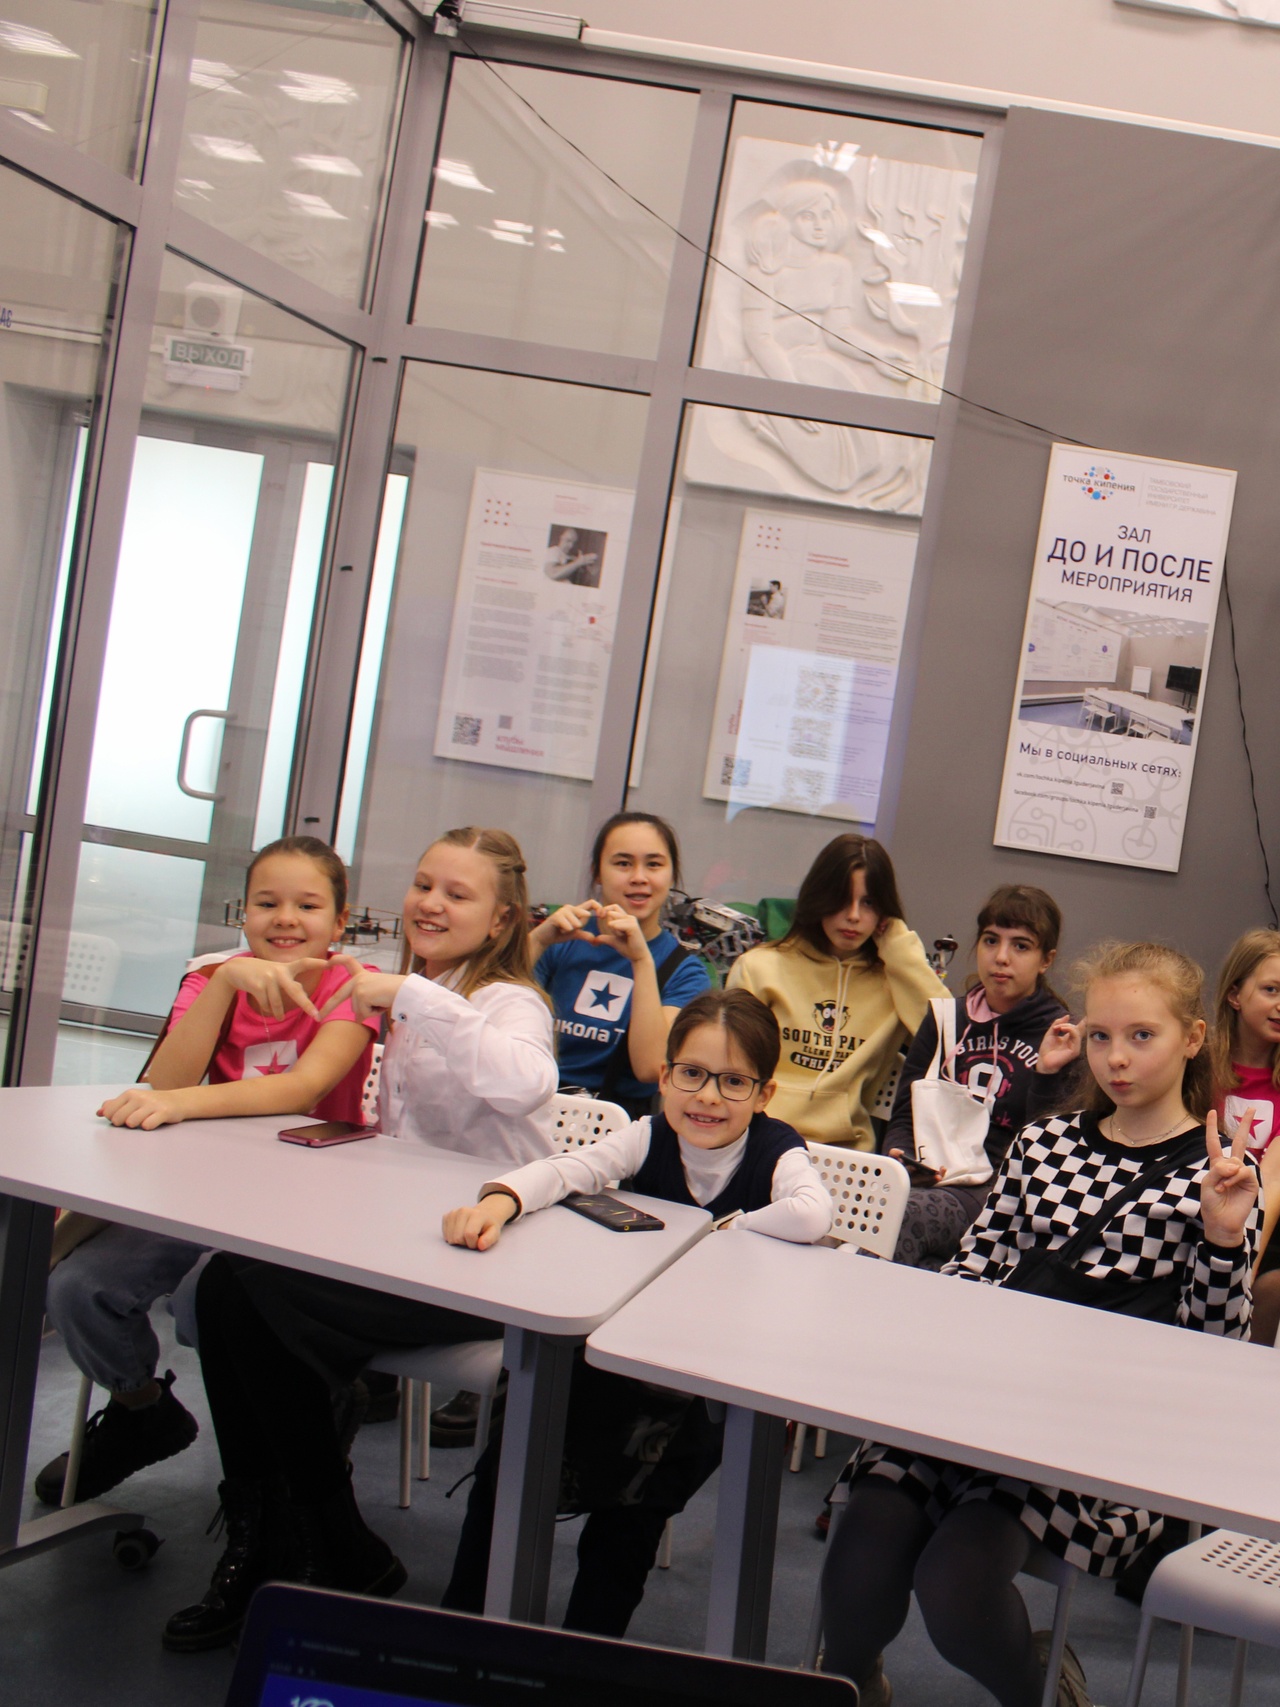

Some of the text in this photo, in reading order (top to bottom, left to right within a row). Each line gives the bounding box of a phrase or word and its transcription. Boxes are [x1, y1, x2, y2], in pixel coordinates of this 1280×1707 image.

[176, 344, 242, 367] ВЫХОД
[1063, 474, 1136, 493] точка кипения
[1117, 525, 1151, 544] ЗАЛ
[1047, 537, 1213, 583] ДО И ПОСЛЕ
[1061, 569, 1193, 603] МЕРОПРИЯТИЯ
[1019, 742, 1182, 778] Мы в социальных сетях:
[782, 1027, 832, 1047] SOUTH
